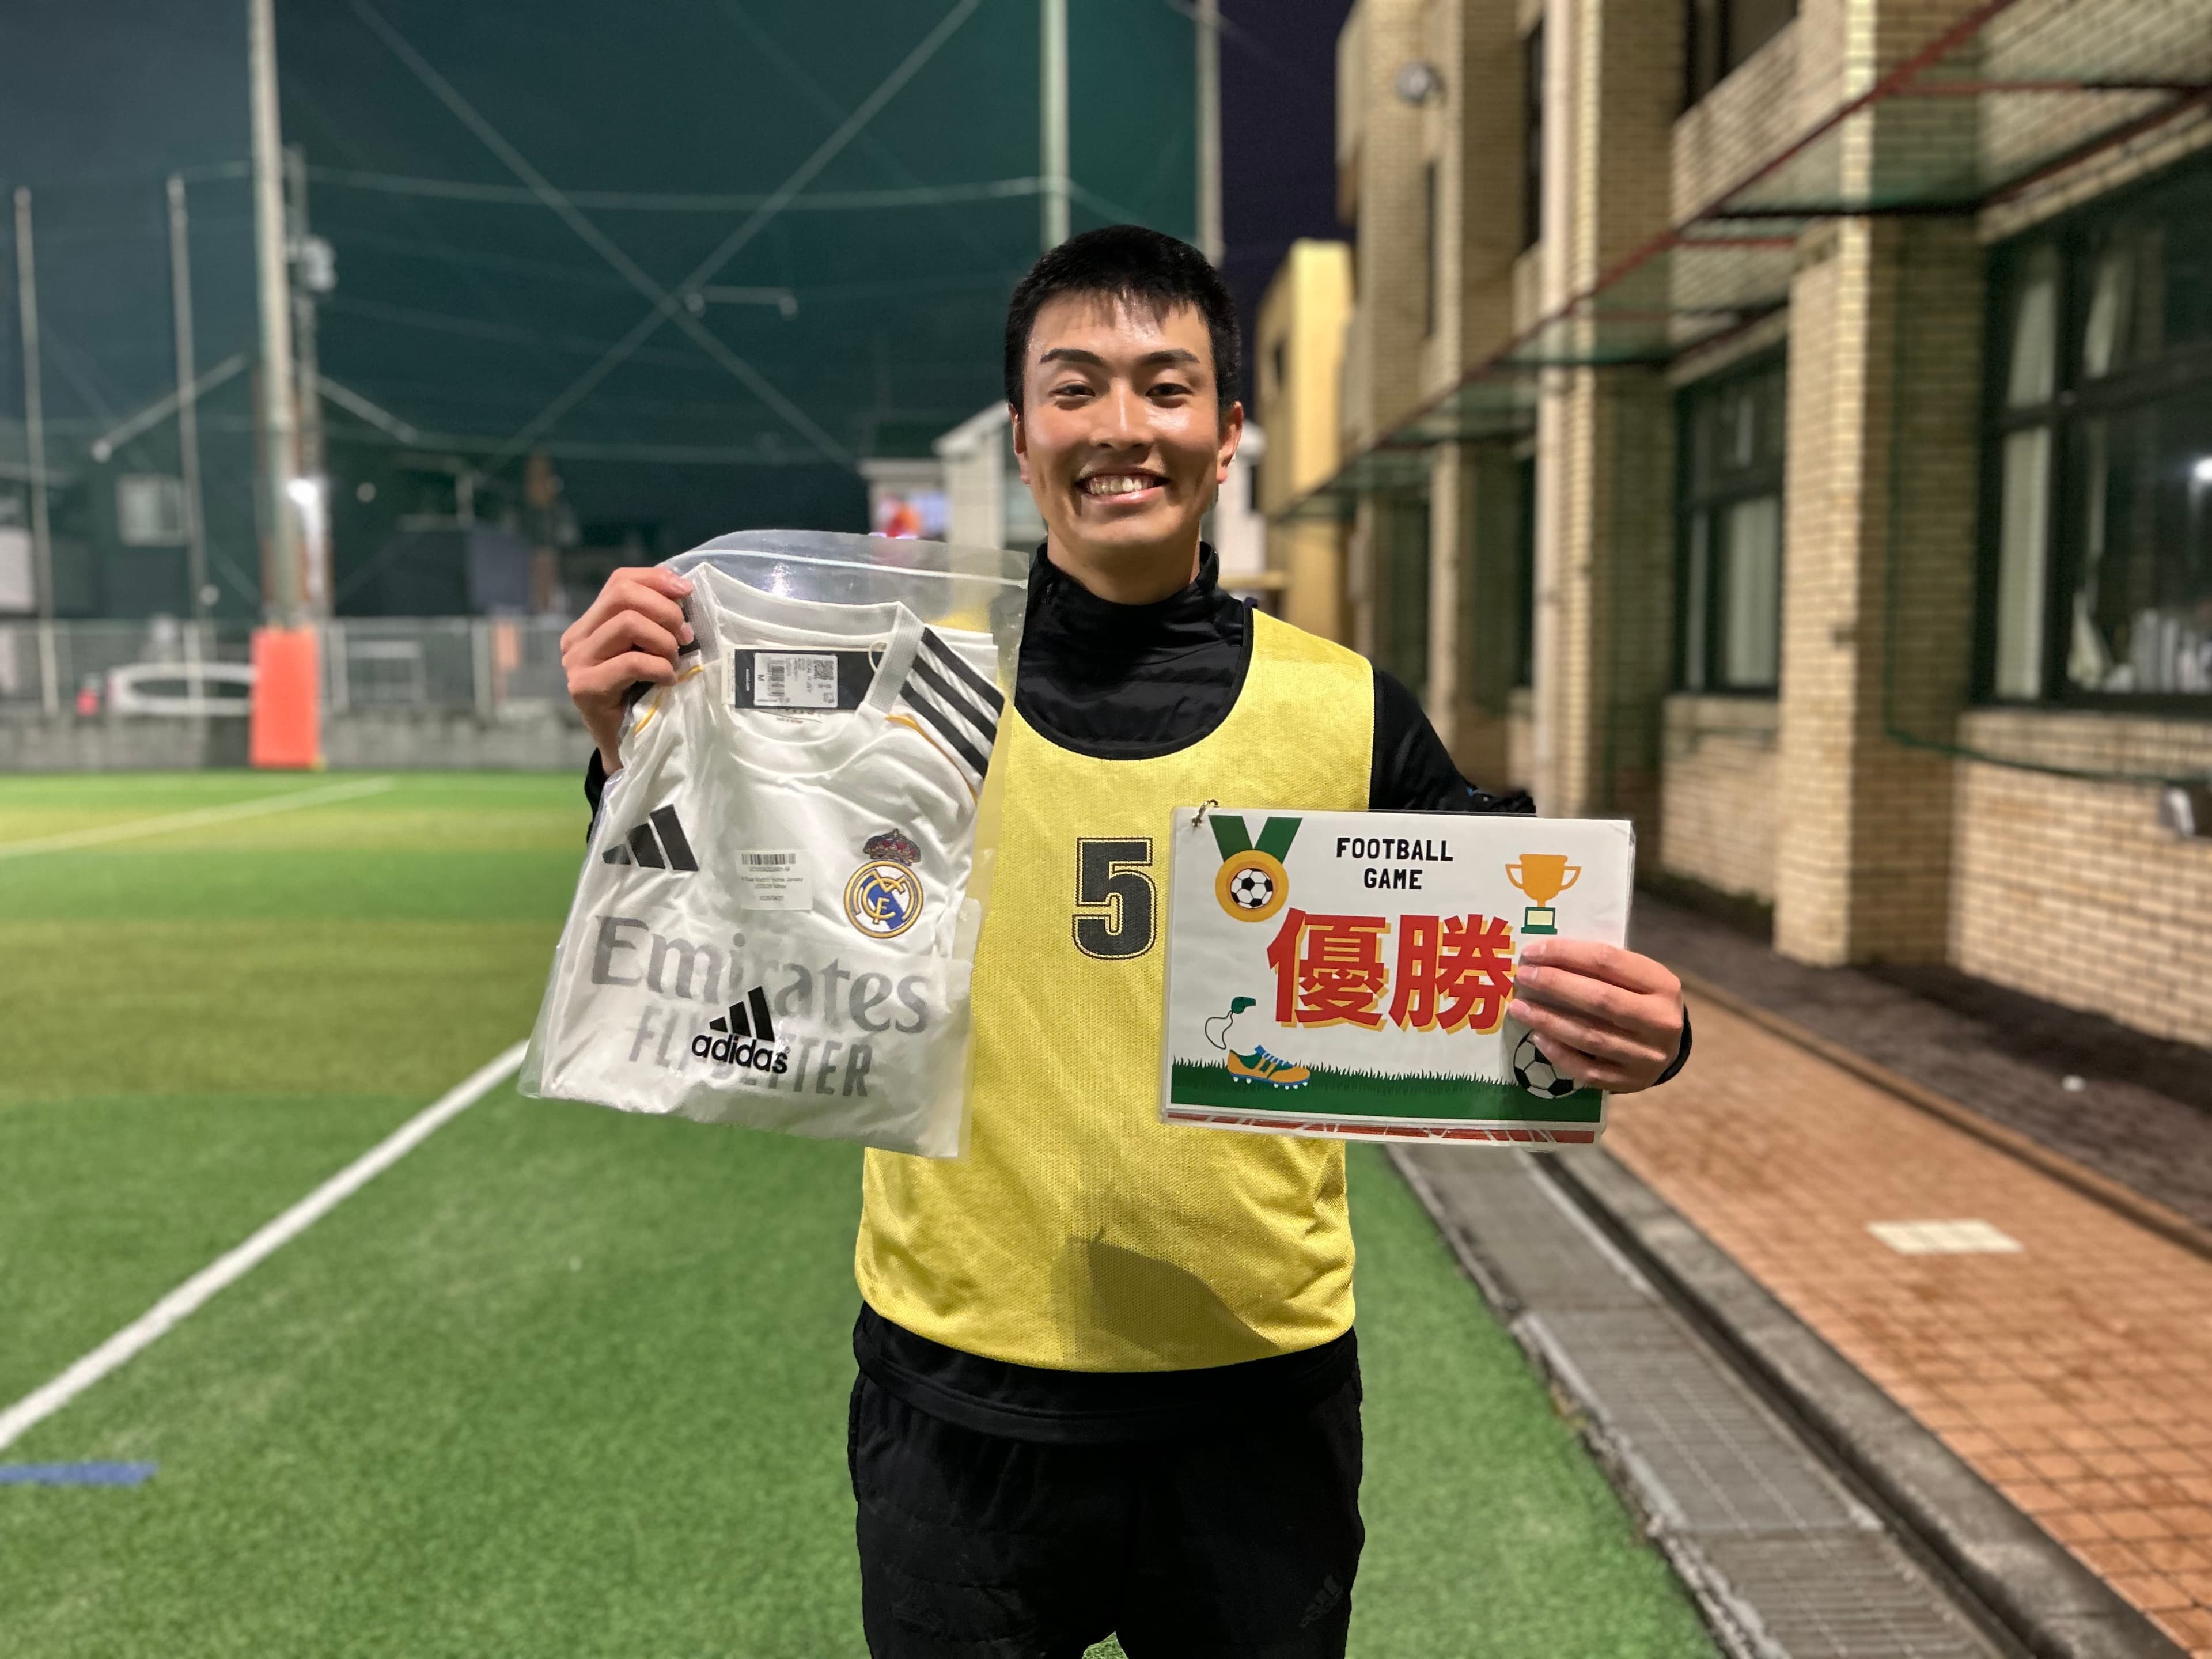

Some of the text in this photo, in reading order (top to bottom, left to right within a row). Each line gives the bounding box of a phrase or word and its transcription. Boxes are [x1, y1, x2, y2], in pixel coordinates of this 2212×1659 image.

[1336, 837, 1453, 861] FOOTBALL
[1364, 868, 1423, 890] GAME
[1072, 838, 1156, 960] 5
[590, 915, 933, 1035] Emirates
[1267, 907, 1516, 1035] 優勝
[691, 1033, 788, 1074] adidas
